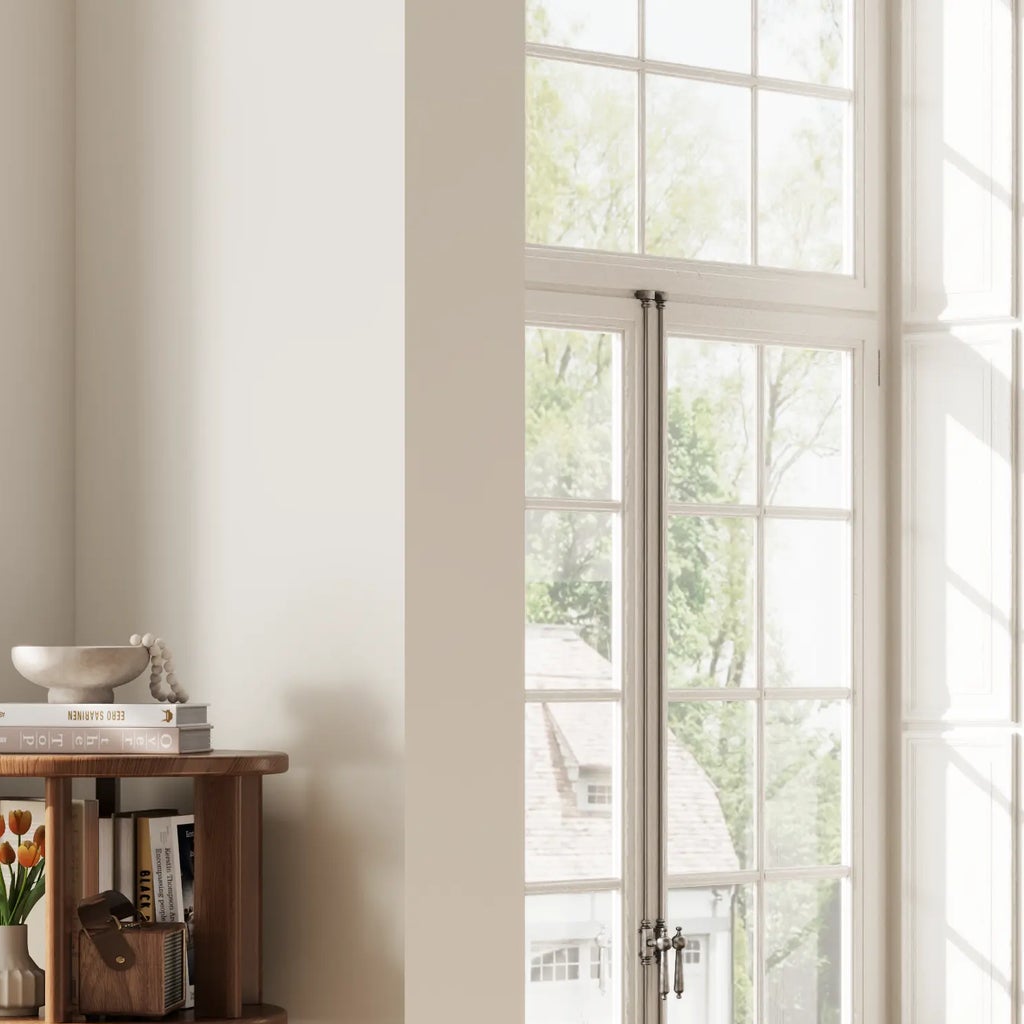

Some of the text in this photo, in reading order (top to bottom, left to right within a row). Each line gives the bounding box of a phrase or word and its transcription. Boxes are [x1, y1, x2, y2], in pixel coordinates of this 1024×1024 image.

[67, 710, 125, 721] EERO SAARINEN
[139, 870, 151, 909] BLACK
[156, 848, 164, 898] Encompassing
[166, 874, 175, 911] Thompson
